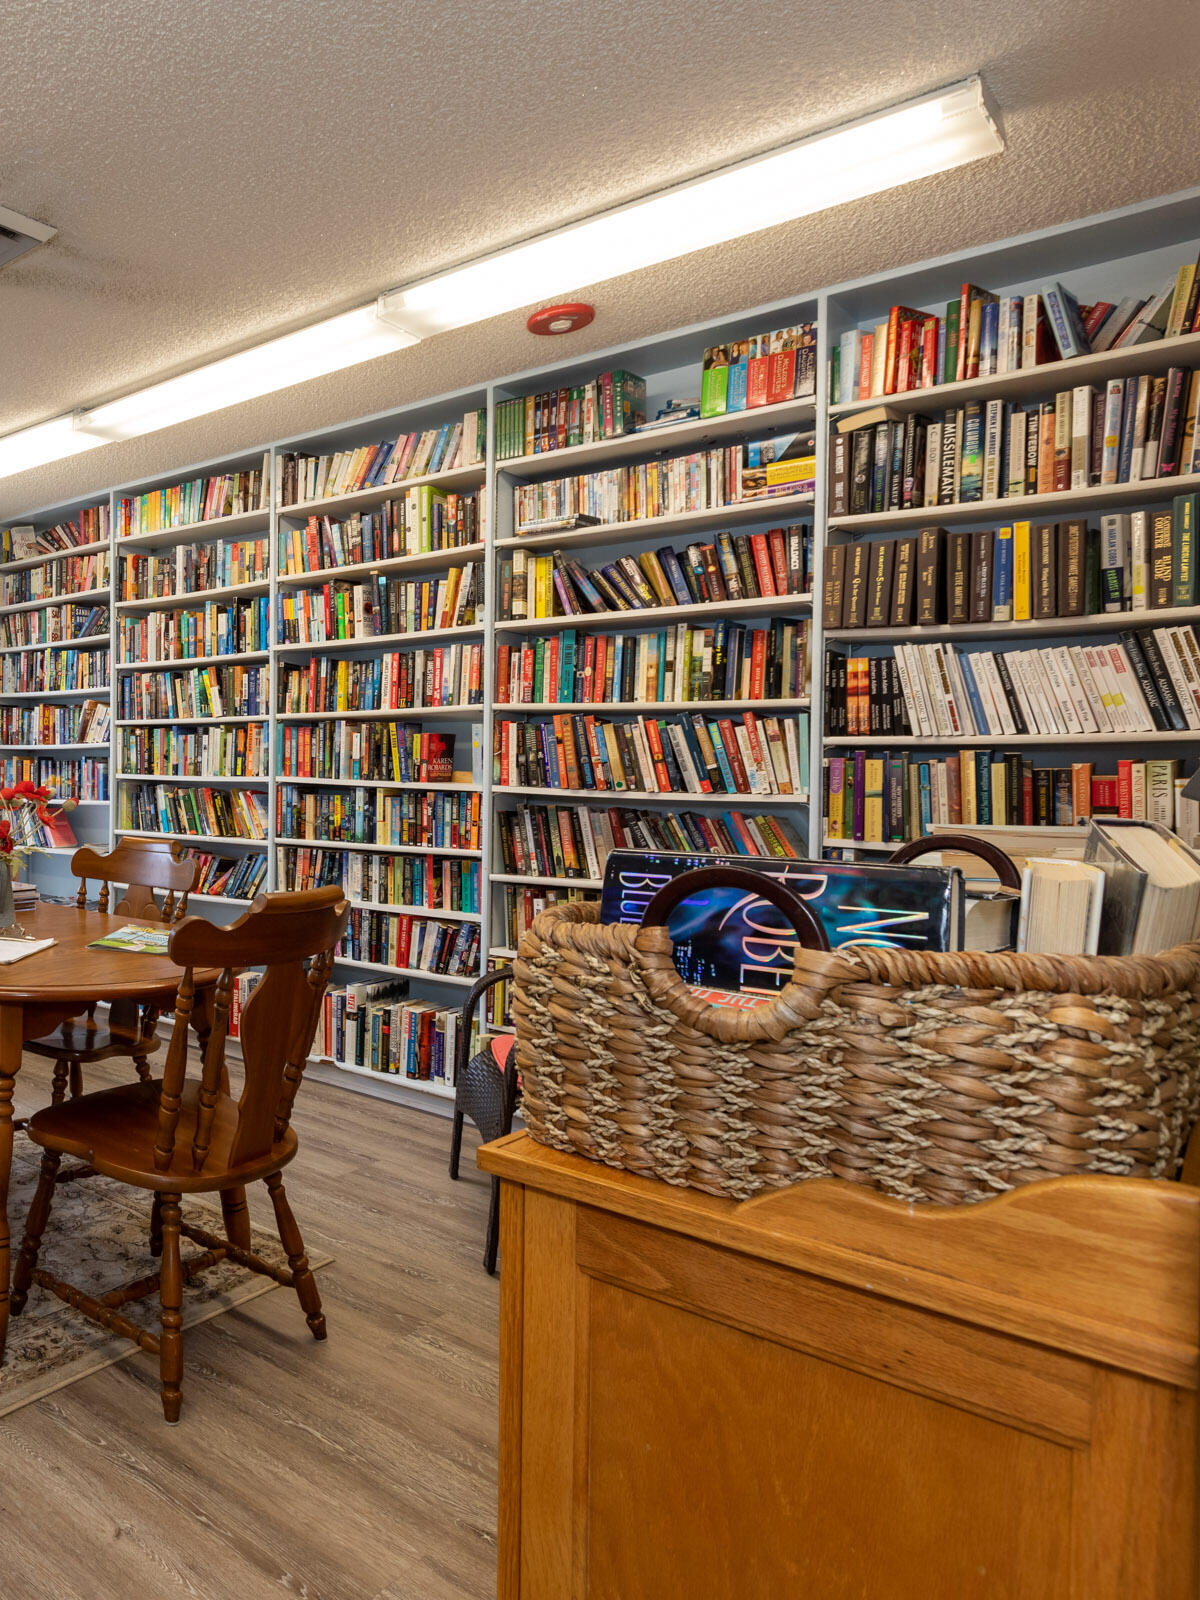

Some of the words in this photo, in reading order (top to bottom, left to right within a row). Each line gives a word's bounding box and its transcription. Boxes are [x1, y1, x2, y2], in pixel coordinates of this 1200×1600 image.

[776, 355, 784, 393] DAUGHTERS
[990, 403, 998, 425] STEPHEN
[1028, 416, 1038, 432] TIM
[966, 418, 980, 454] COLUMBUS
[988, 432, 996, 456] AMBROSE
[929, 448, 937, 464] BOX
[942, 424, 956, 495] MISSILEMAN
[1026, 434, 1037, 466] TEBOW
[309, 519, 317, 534] Wolf
[1154, 517, 1163, 549] COULTER
[1163, 516, 1171, 547] CATHERINE
[1182, 532, 1190, 541] THE
[1108, 528, 1116, 547] HARLAN
[759, 550, 767, 566] DAVID
[790, 541, 799, 570] BALDACCI
[1107, 549, 1116, 566] COBEN
[1181, 542, 1190, 562] LINCOLN
[761, 567, 769, 590] BALDACCI
[1154, 559, 1163, 580] SIDE
[1162, 555, 1171, 581] BLIND
[1180, 563, 1189, 581] LAWYER
[955, 572, 963, 586] STEVE
[955, 587, 963, 605] MARTIN
[900, 667, 909, 692] AMAZING
[1126, 639, 1134, 648] The
[1141, 679, 1158, 707] ALMANAC
[1142, 637, 1151, 647] The
[1158, 678, 1175, 706] ALMANAC
[1062, 701, 1070, 712] Book
[1077, 700, 1085, 712] Book
[1080, 712, 1089, 721] Five
[1065, 713, 1073, 722] Five
[579, 735, 587, 755] CUSSLER
[591, 735, 599, 755] CUSSLER
[1152, 765, 1168, 798] PARIS
[1119, 780, 1128, 808] WEBSTER'S
[632, 826, 646, 848] EDGAR
